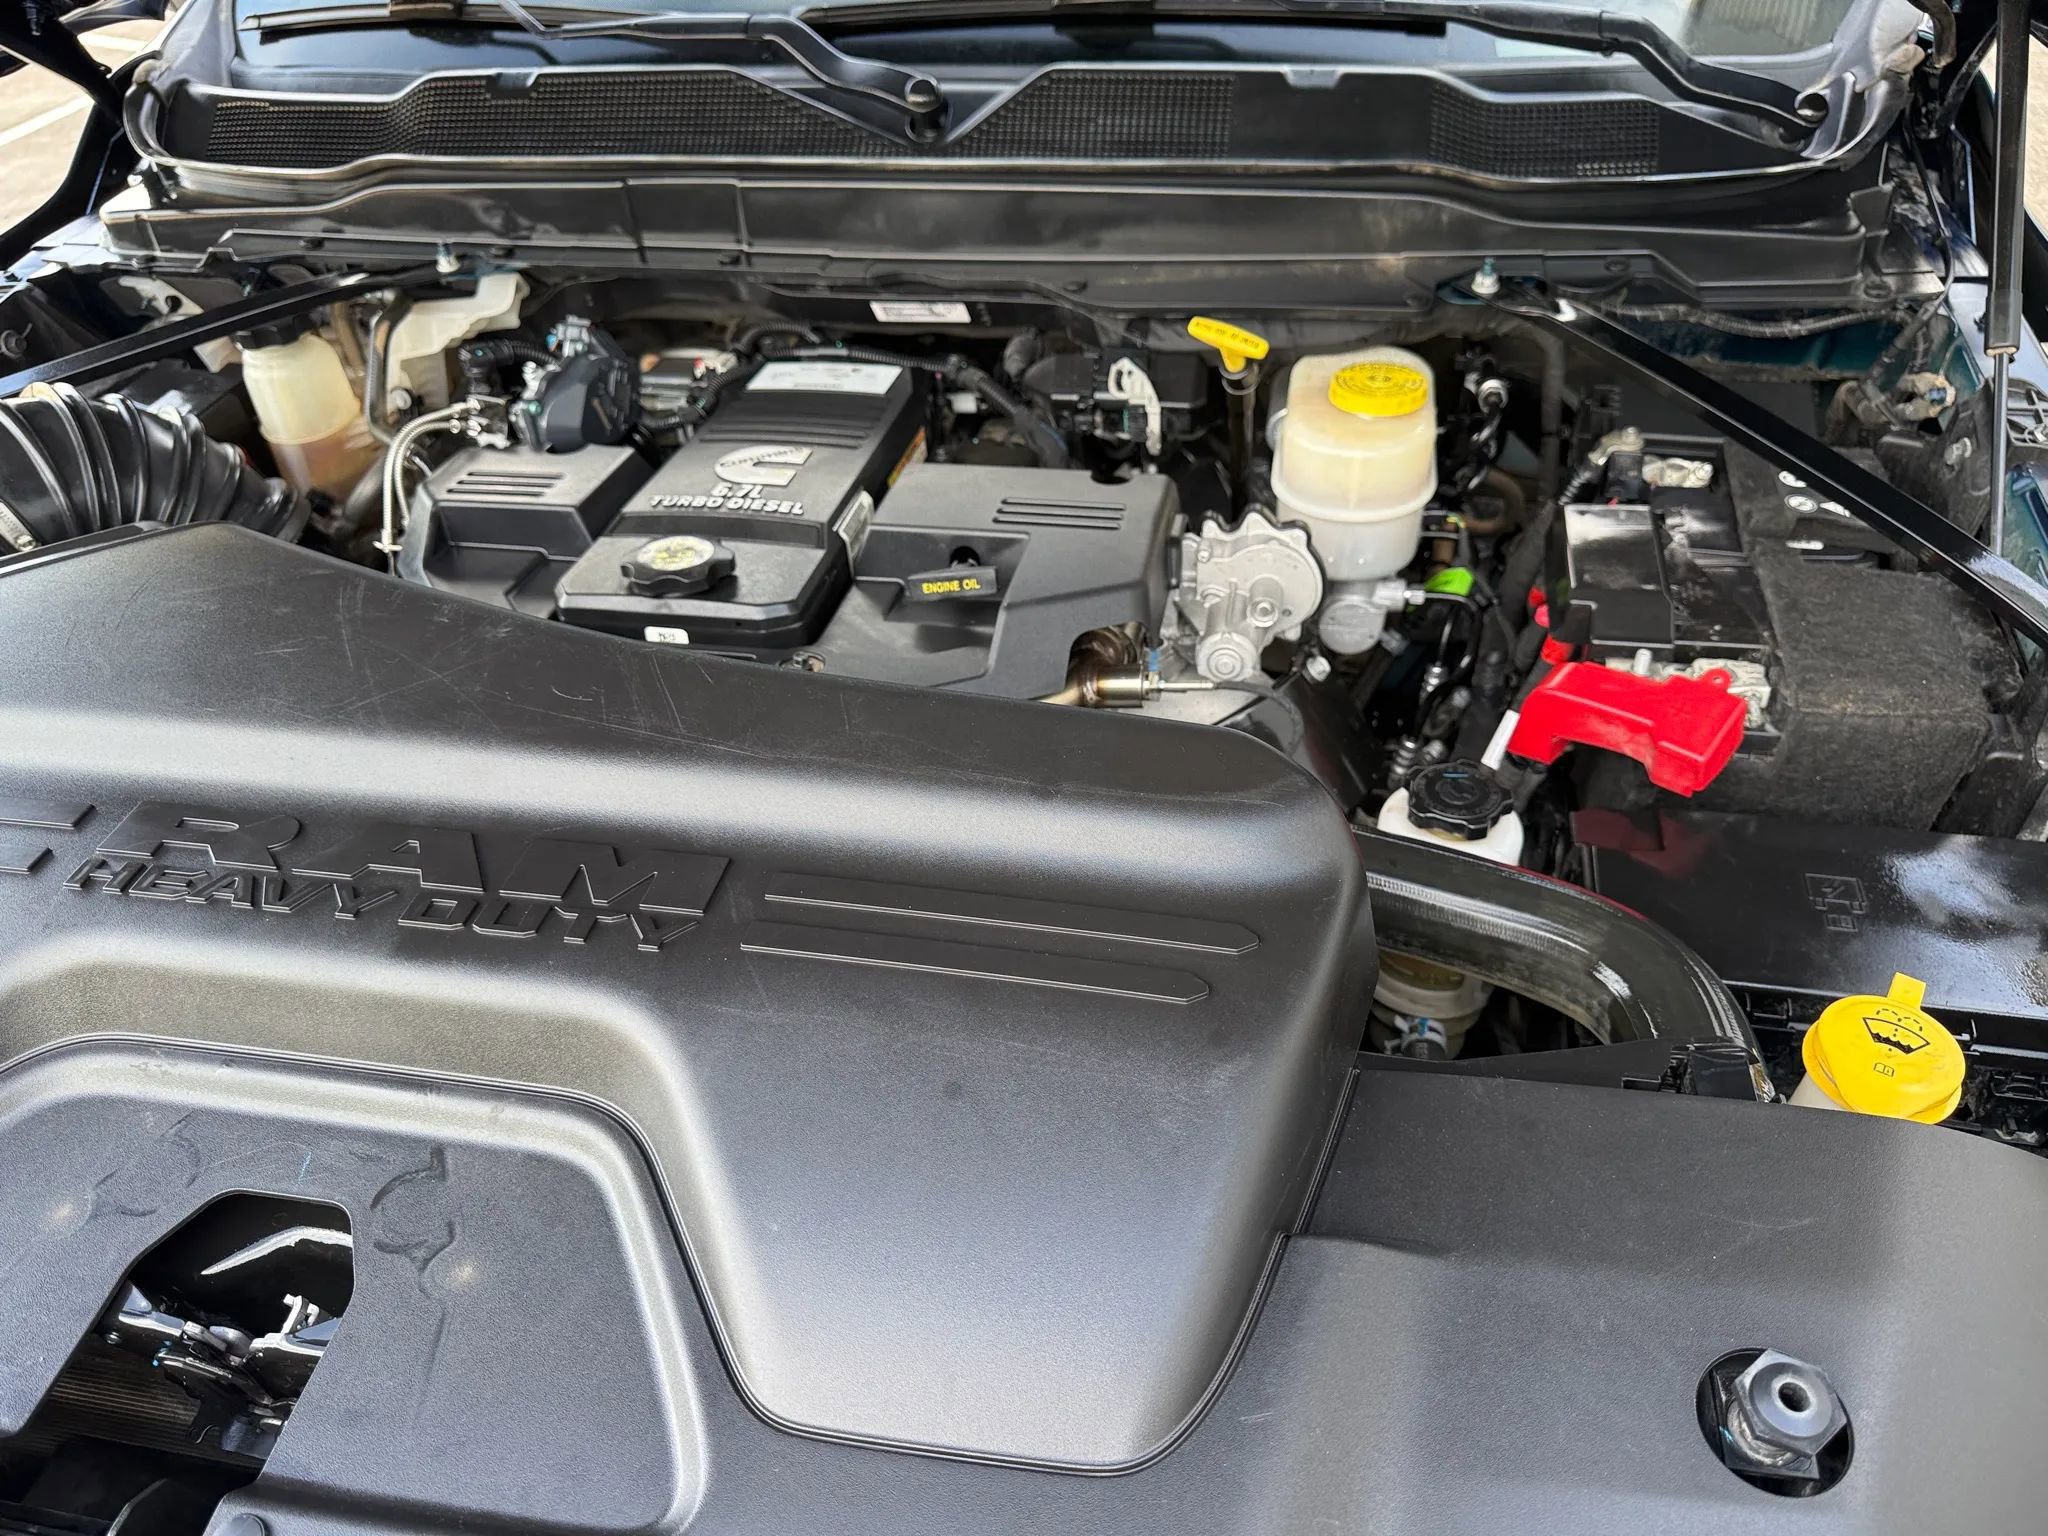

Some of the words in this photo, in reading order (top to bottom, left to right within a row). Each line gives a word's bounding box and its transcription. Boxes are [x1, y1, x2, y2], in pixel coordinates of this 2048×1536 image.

[710, 481, 764, 498] 6.7L
[651, 494, 725, 509] TURBO
[726, 497, 804, 515] DIESEL
[921, 580, 961, 594] ENGINE
[962, 578, 981, 590] OIL
[95, 800, 731, 916] RAM
[62, 856, 399, 920] HEAVY
[397, 898, 703, 953] DUTY
